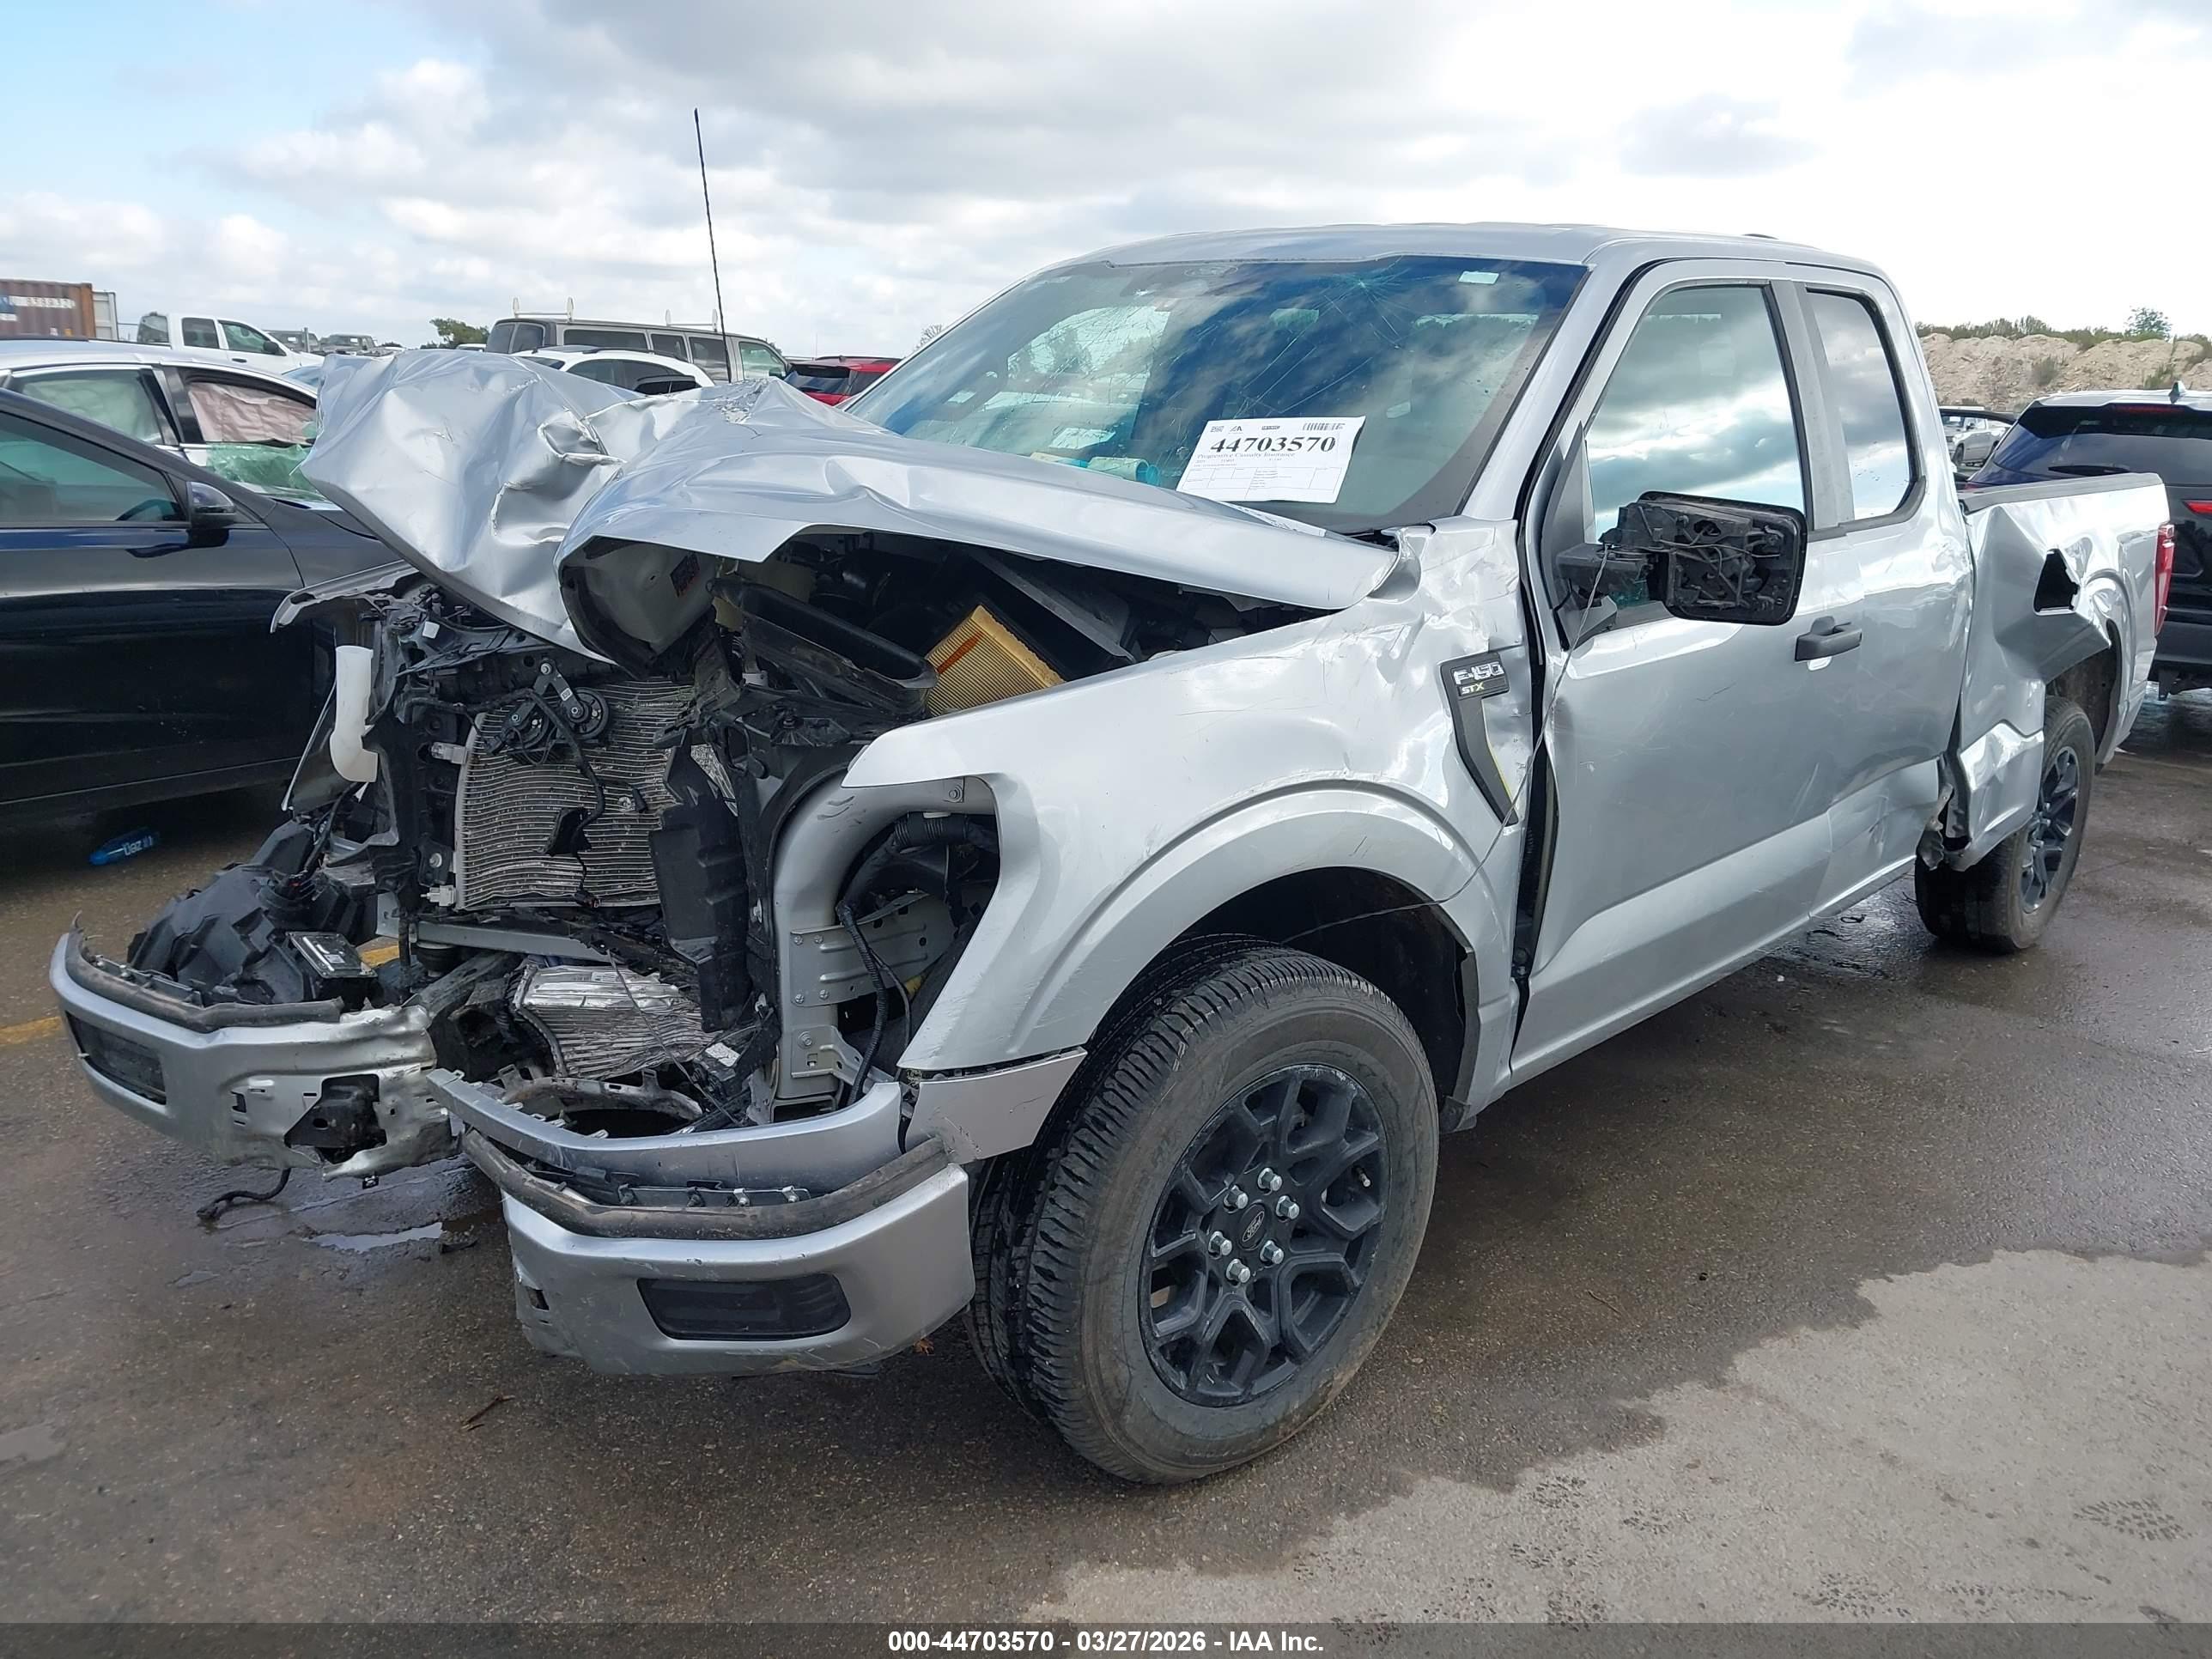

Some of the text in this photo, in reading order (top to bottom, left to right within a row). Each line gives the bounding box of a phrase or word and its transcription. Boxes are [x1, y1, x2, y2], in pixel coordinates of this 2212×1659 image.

[1210, 436, 1336, 453] 44703570
[1453, 661, 1505, 685] F-150
[1462, 681, 1485, 695] STX
